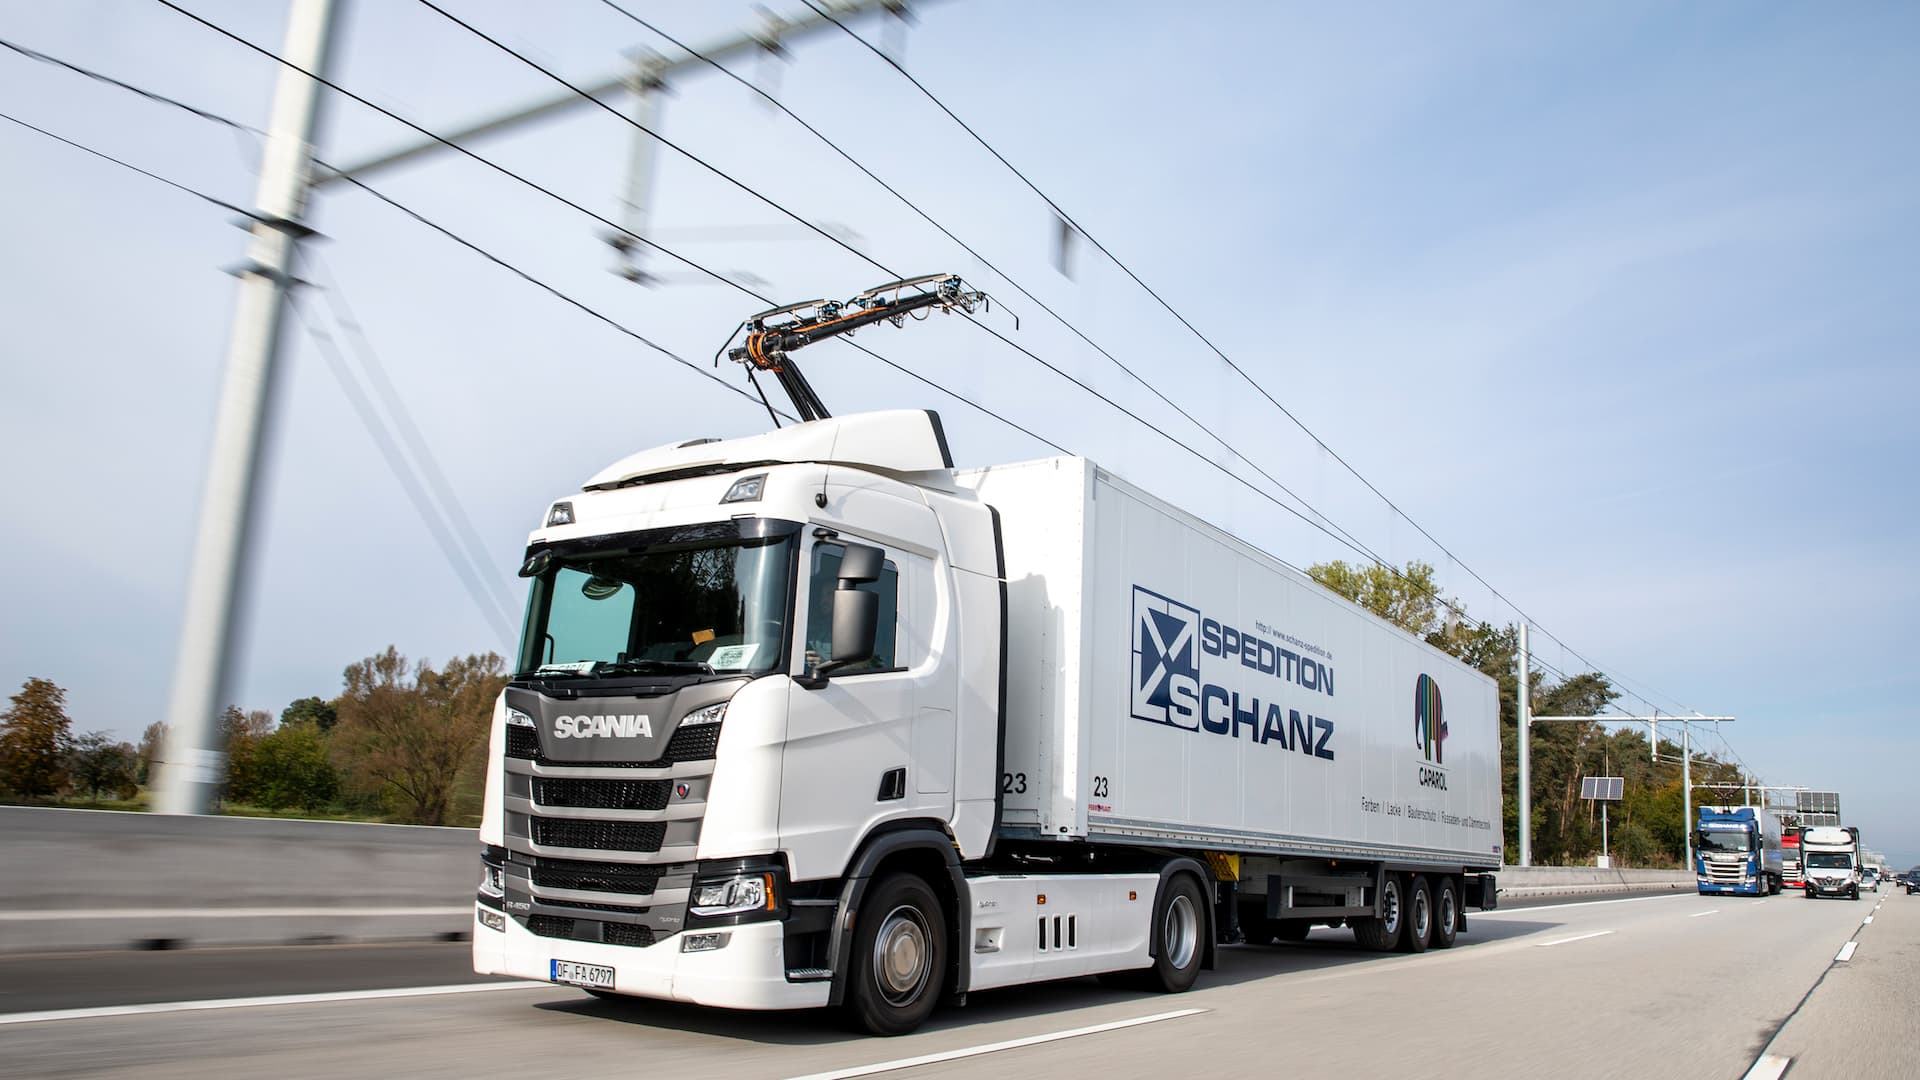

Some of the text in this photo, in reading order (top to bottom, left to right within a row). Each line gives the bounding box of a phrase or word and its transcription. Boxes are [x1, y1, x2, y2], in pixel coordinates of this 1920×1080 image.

[1202, 617, 1334, 697] SPEDITION
[553, 714, 653, 739] SCANIA
[1168, 672, 1335, 761] SCHANZ
[1003, 773, 1027, 794] 23
[1094, 776, 1108, 798] 23
[1418, 766, 1448, 791] CAPAROL
[1361, 795, 1380, 814] Farben
[1386, 800, 1401, 817] Lacke
[589, 967, 612, 985] 6797
